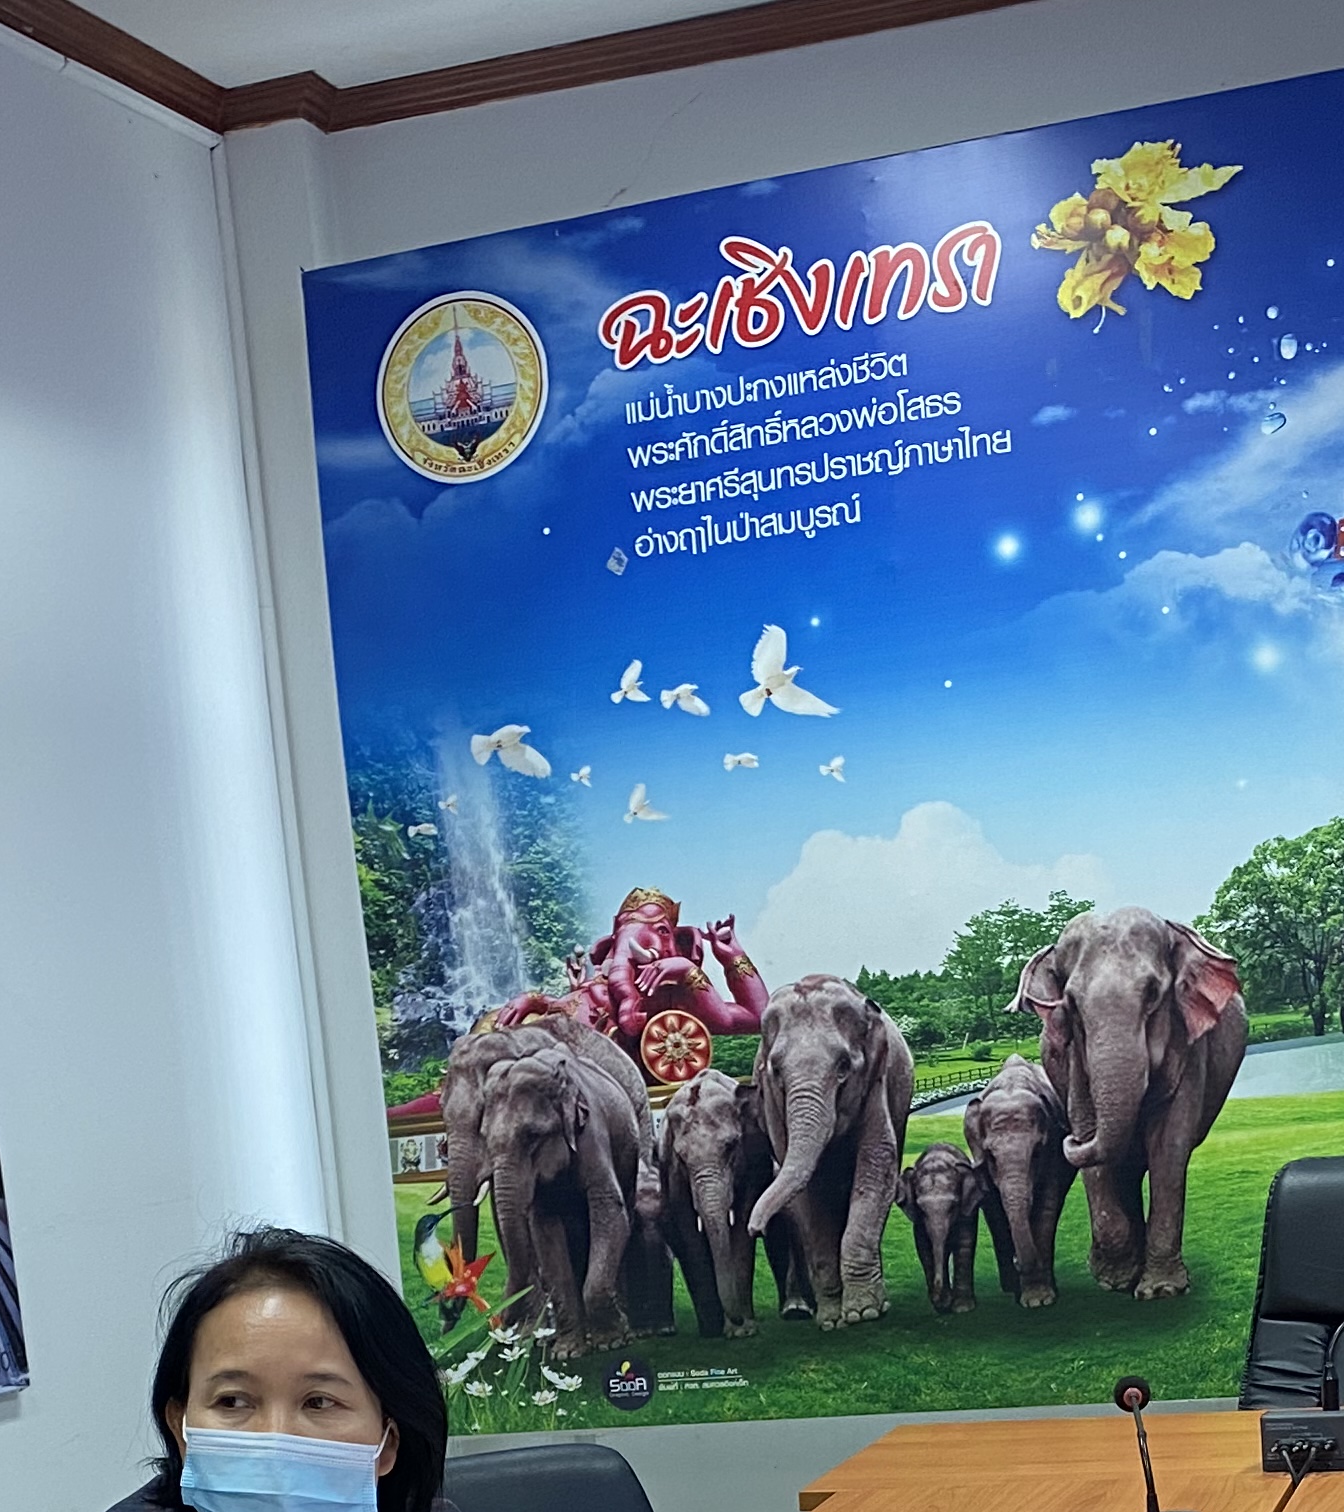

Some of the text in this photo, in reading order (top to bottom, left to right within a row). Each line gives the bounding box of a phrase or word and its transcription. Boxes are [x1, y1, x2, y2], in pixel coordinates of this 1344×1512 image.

[601, 224, 999, 366] ฉะเชิงเทรา
[625, 352, 908, 425] แม่น้ำบางปะกงแหล่งชีวิต
[627, 389, 962, 468] พระศักดิ์สิทธิ์หลวงพ่อโสธร
[631, 426, 1012, 512] พระยาศรีสุนทรปราชญ์ภาษาไทย
